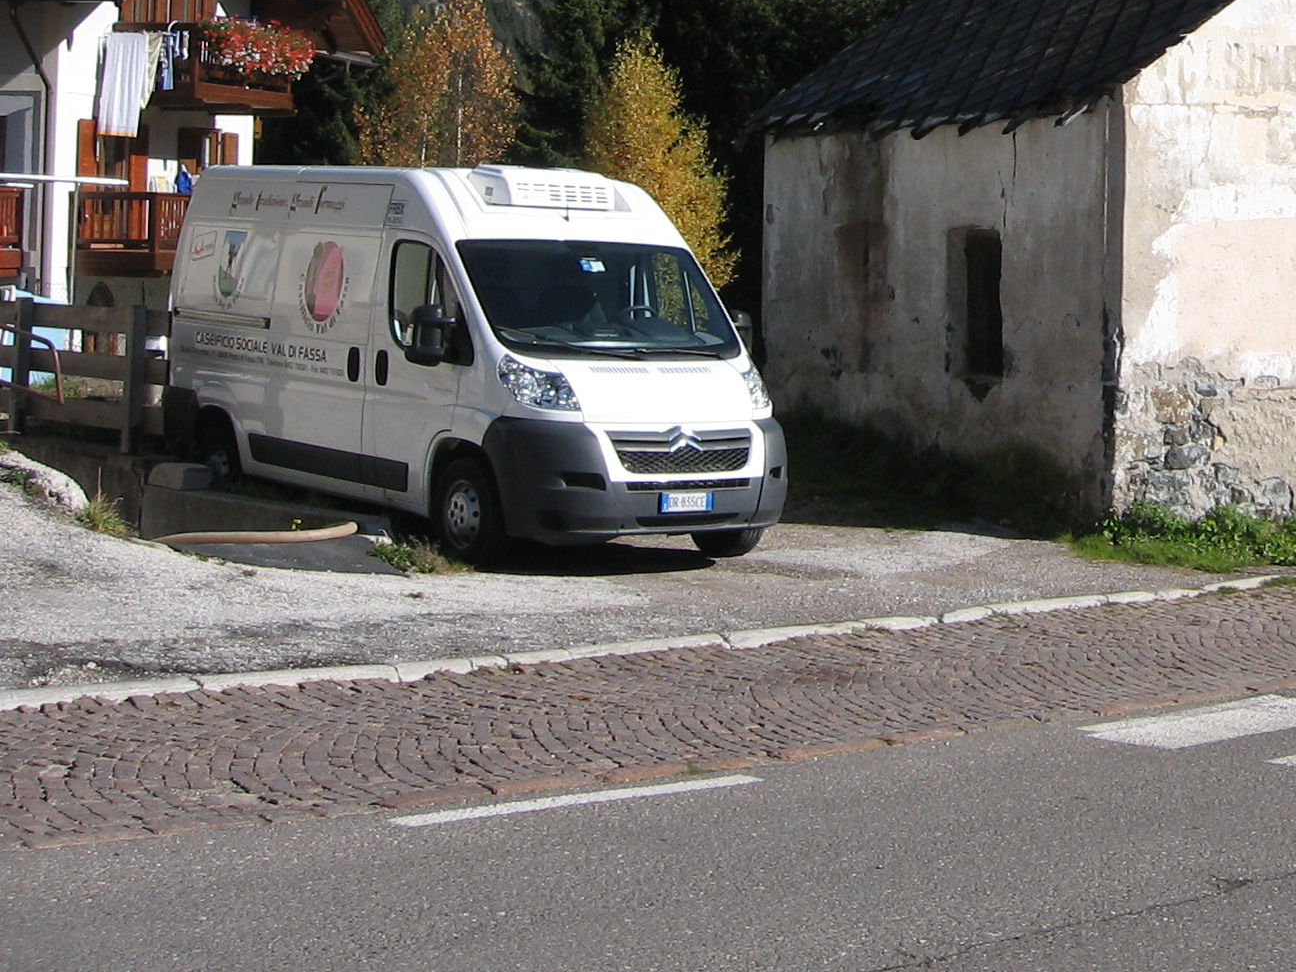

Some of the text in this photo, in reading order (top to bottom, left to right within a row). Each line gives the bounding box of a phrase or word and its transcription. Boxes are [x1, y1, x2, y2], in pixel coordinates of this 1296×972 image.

[194, 330, 235, 349] CASEIFICIO
[235, 336, 268, 354] SOCIALE
[271, 342, 286, 357] VAL
[288, 344, 297, 358] DI
[298, 346, 328, 362] FASSA
